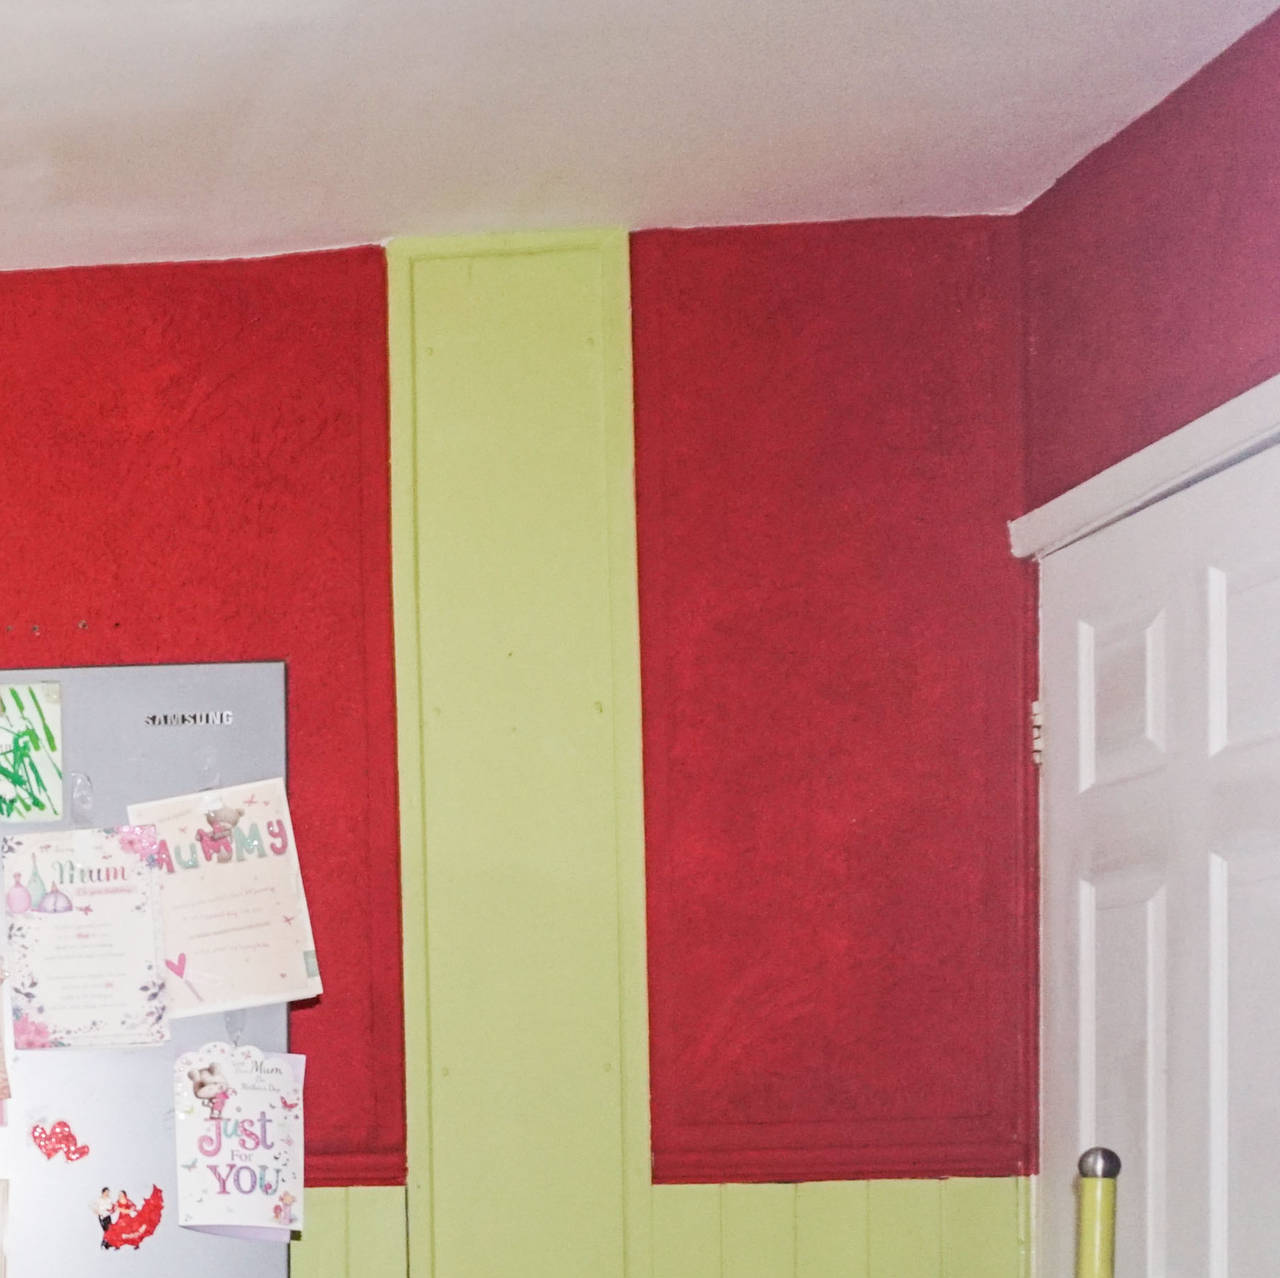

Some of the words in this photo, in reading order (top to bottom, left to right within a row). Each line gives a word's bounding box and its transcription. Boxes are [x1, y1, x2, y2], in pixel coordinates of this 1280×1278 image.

[144, 709, 234, 727] SAMSUNG
[53, 859, 128, 885] Mum
[251, 1059, 283, 1076] Mum
[198, 1111, 274, 1157] Just
[231, 1150, 254, 1162] For
[206, 1163, 282, 1196] YOU
